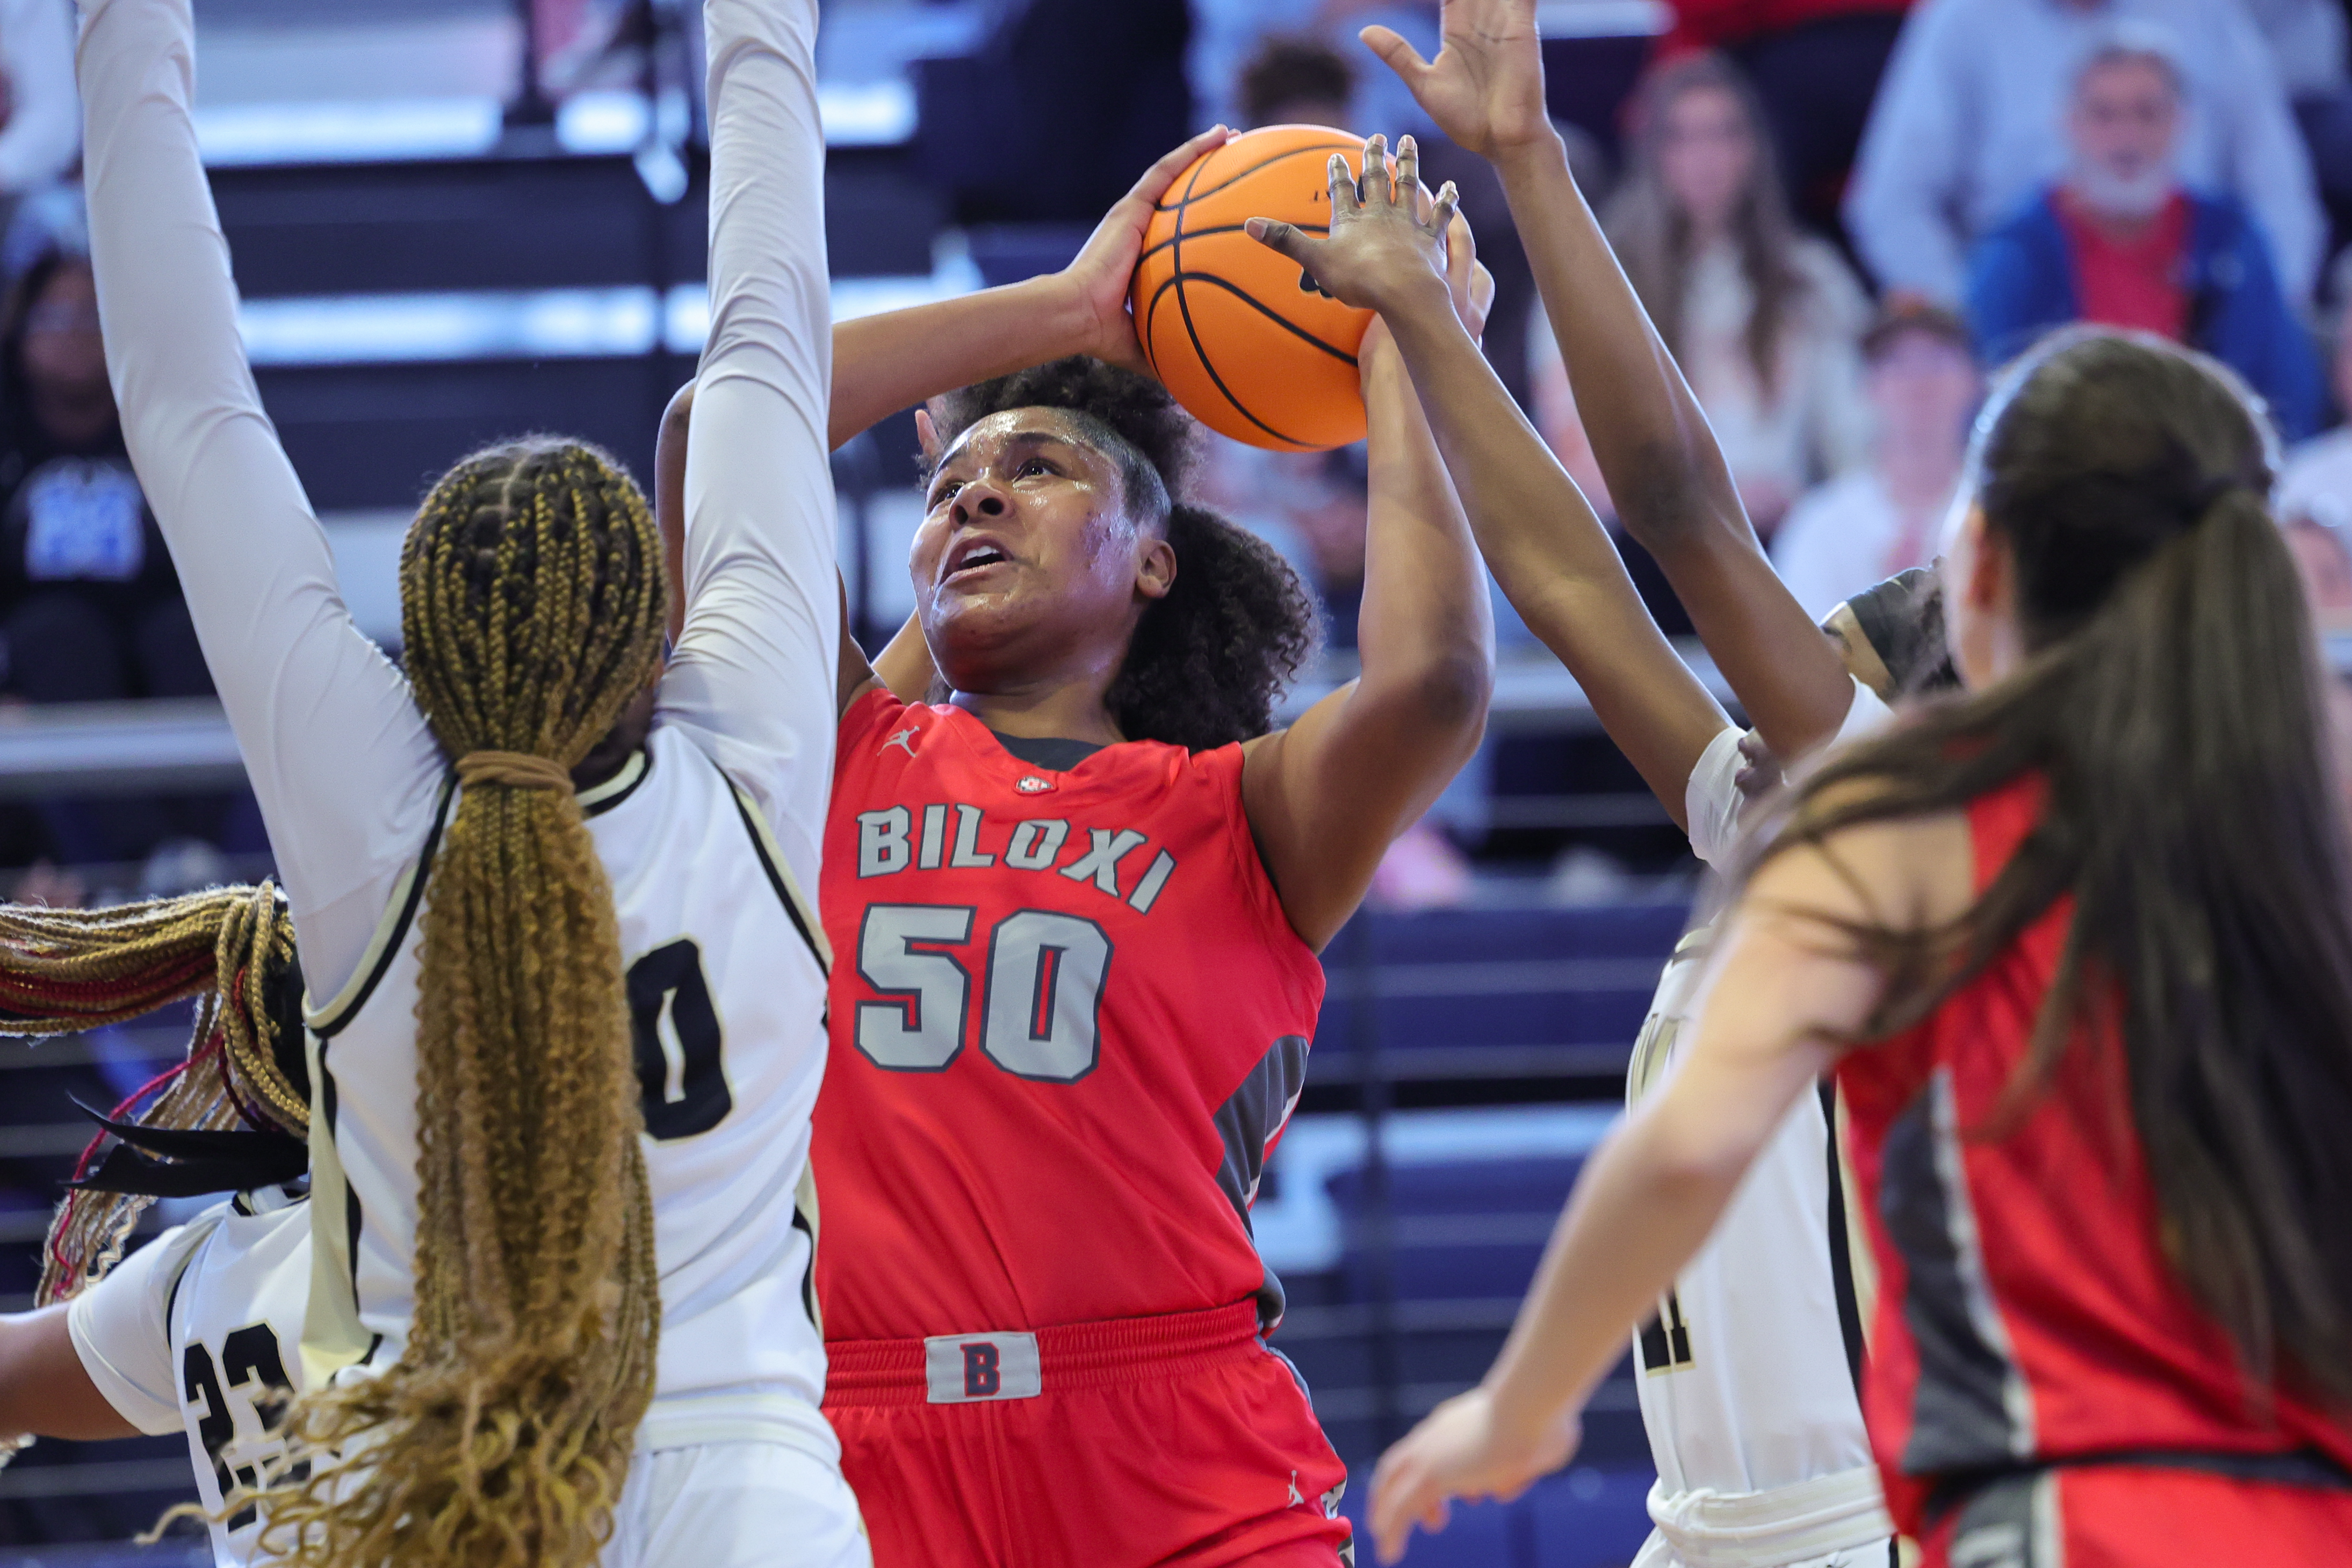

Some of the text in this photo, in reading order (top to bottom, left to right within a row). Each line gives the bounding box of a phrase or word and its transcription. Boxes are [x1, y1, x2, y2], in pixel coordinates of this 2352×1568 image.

[856, 804, 1177, 915] BILOXI
[853, 902, 1114, 1085] 50
[959, 1342, 1000, 1397] B
